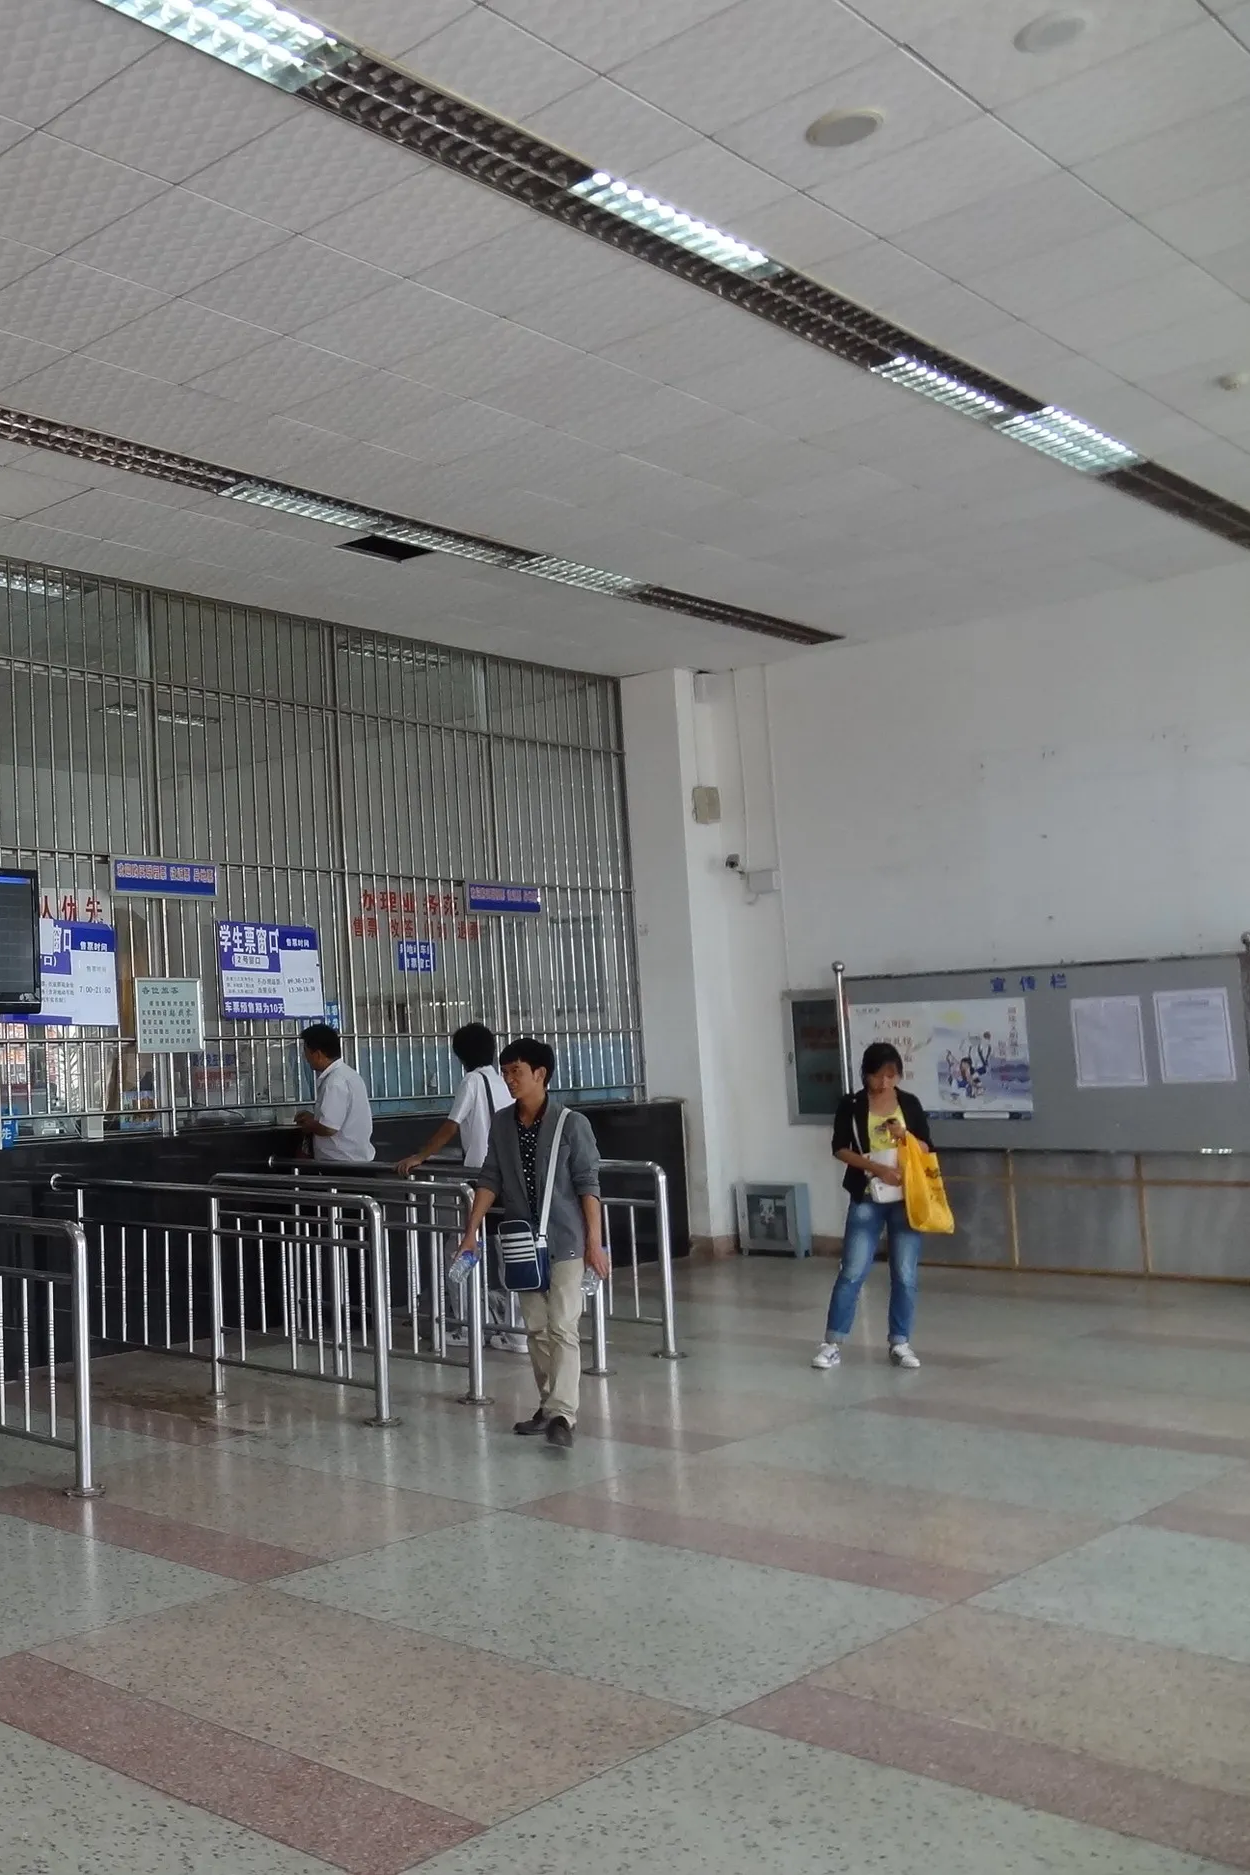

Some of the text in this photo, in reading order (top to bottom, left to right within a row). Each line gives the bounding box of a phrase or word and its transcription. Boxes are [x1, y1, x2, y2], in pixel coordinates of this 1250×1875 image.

[353, 916, 378, 938] 售票
[80, 941, 108, 952] 售票时间
[219, 925, 280, 954] 学生票窗口
[286, 938, 310, 948] 售票时间
[224, 1001, 286, 1015] 车票预售期为10天
